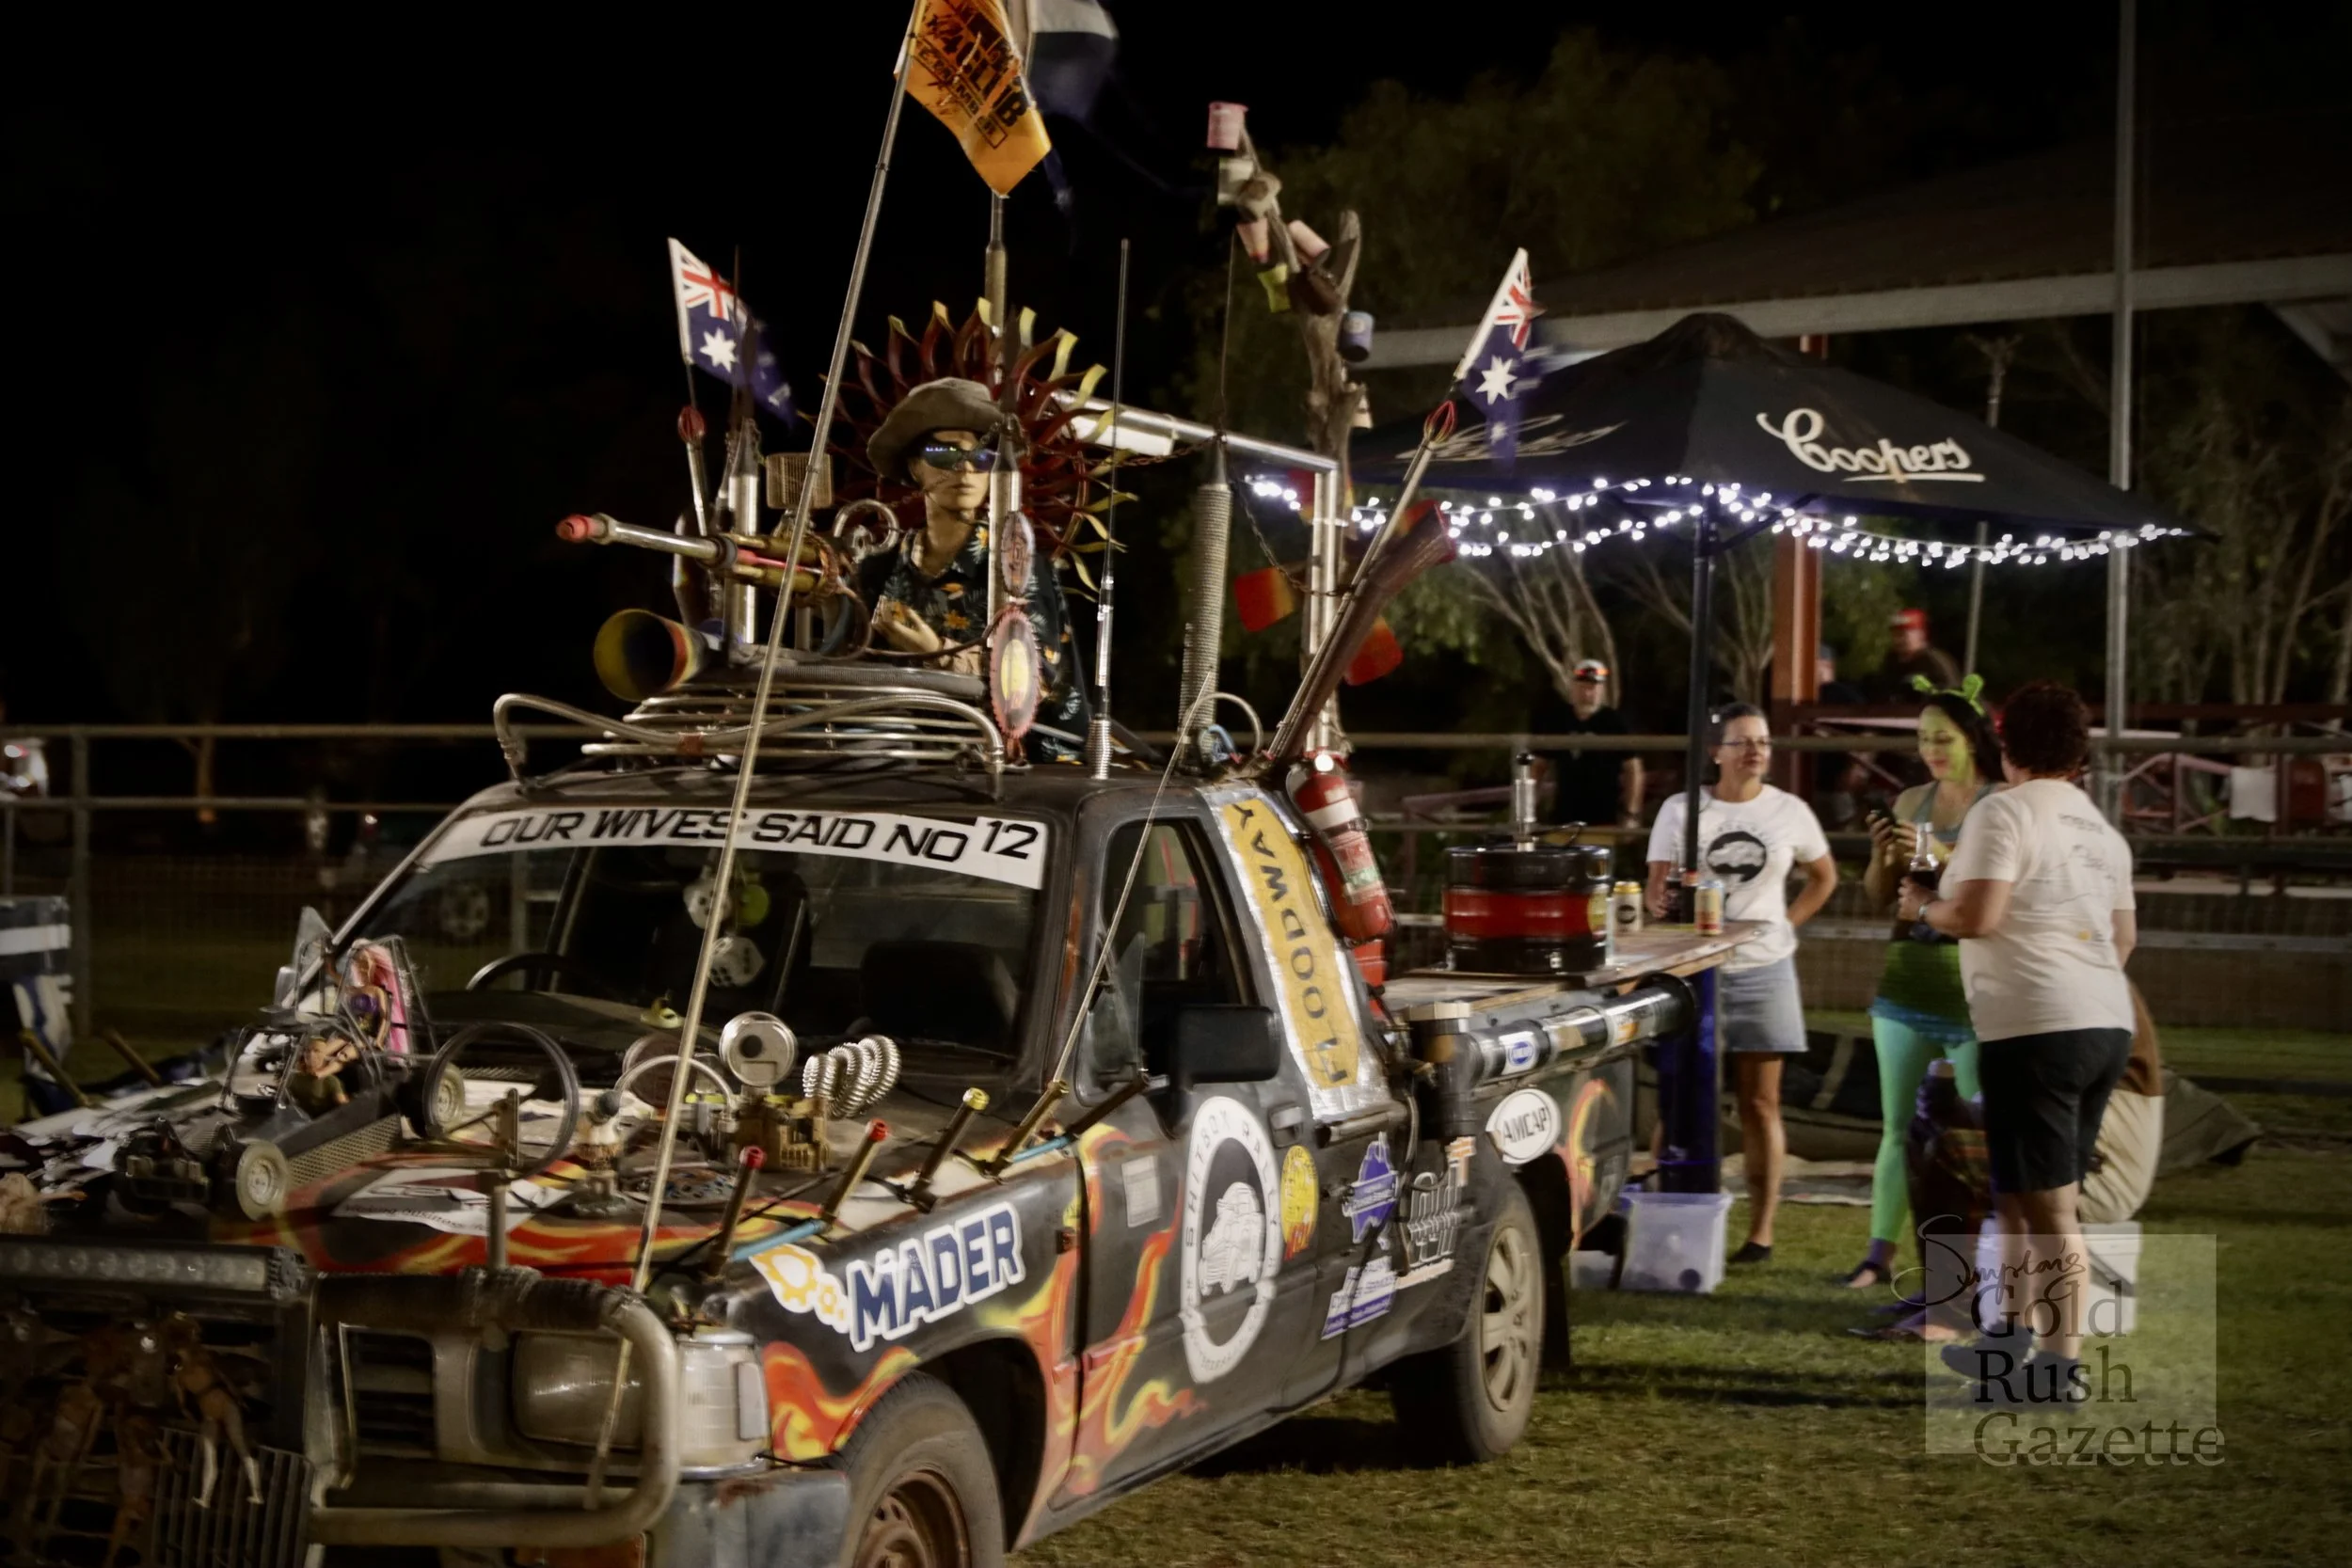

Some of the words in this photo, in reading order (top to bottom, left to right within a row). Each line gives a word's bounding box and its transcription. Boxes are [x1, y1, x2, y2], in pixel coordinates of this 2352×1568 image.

[1756, 408, 1971, 483] Coopers
[480, 812, 585, 847] OUR
[590, 809, 748, 840] WIVES
[753, 813, 876, 849] SAID
[882, 824, 969, 863] NO
[981, 820, 1039, 860] 12
[1233, 803, 1348, 1084] FLOODWAY
[849, 1203, 1025, 1351] MADER
